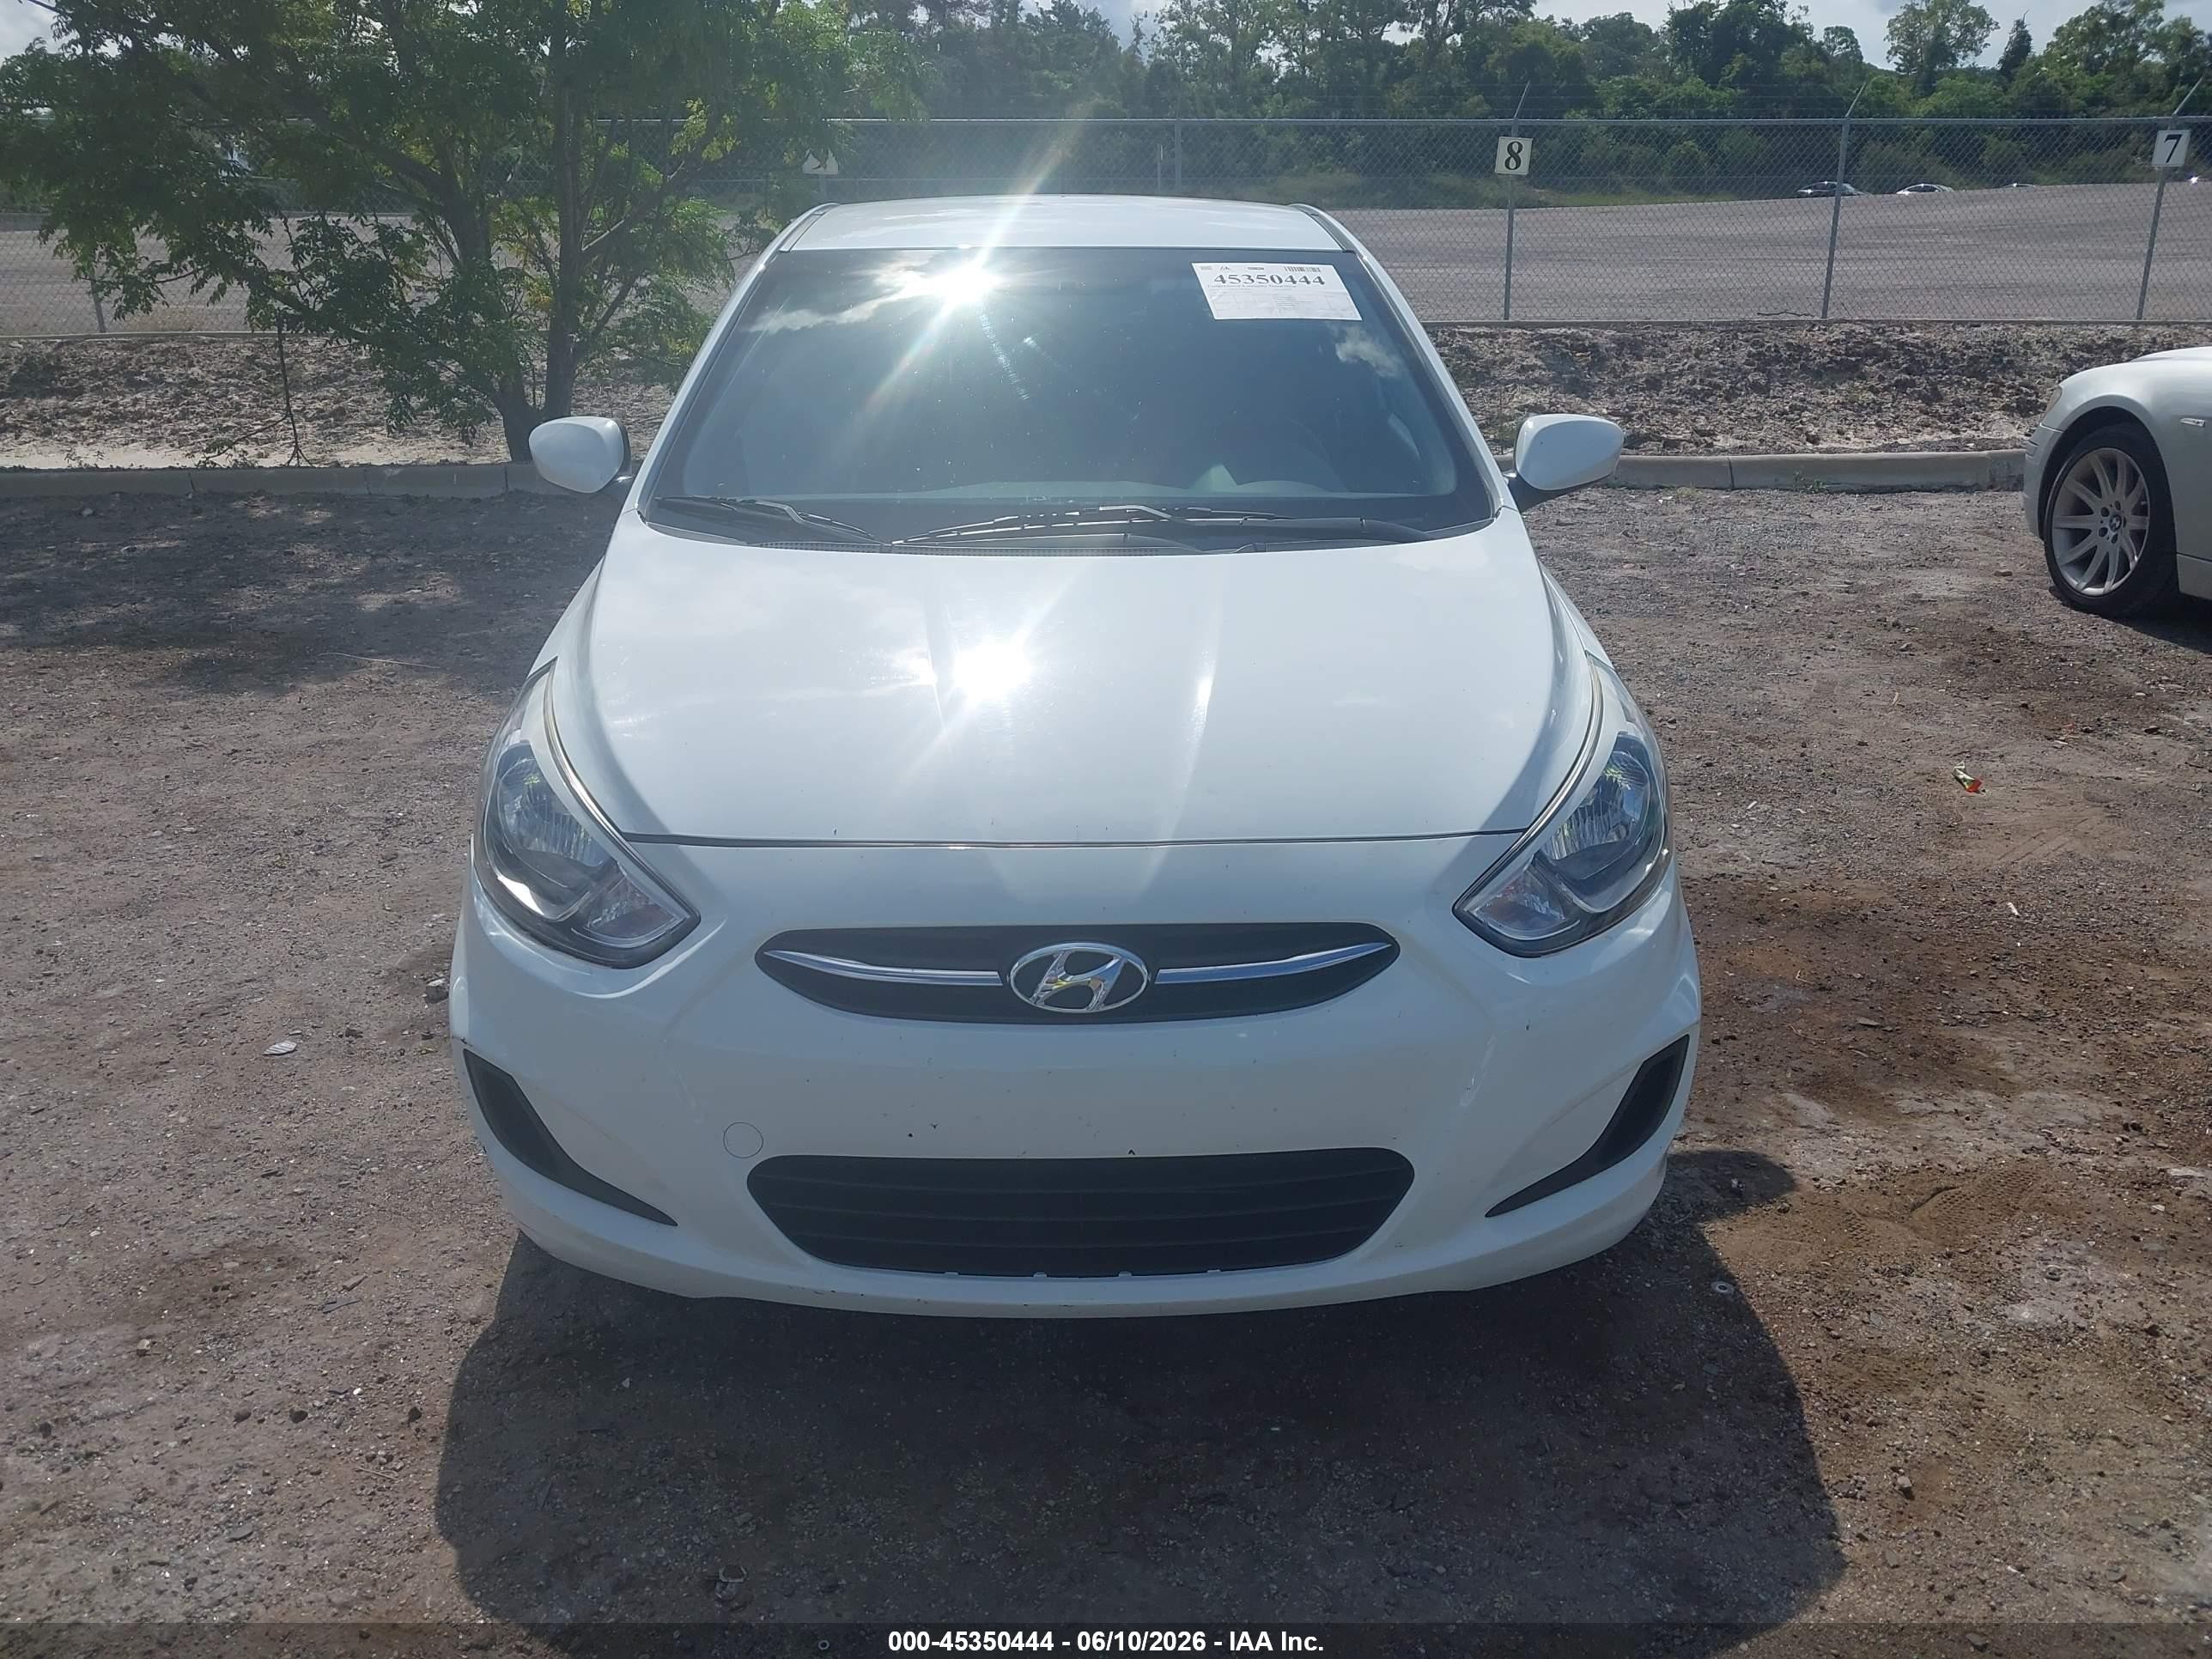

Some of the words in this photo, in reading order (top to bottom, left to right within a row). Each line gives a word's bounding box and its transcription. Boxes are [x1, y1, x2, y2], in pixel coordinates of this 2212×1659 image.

[1504, 141, 1523, 171] 8
[2164, 134, 2183, 163] 7
[1213, 274, 1326, 286] 45350444
